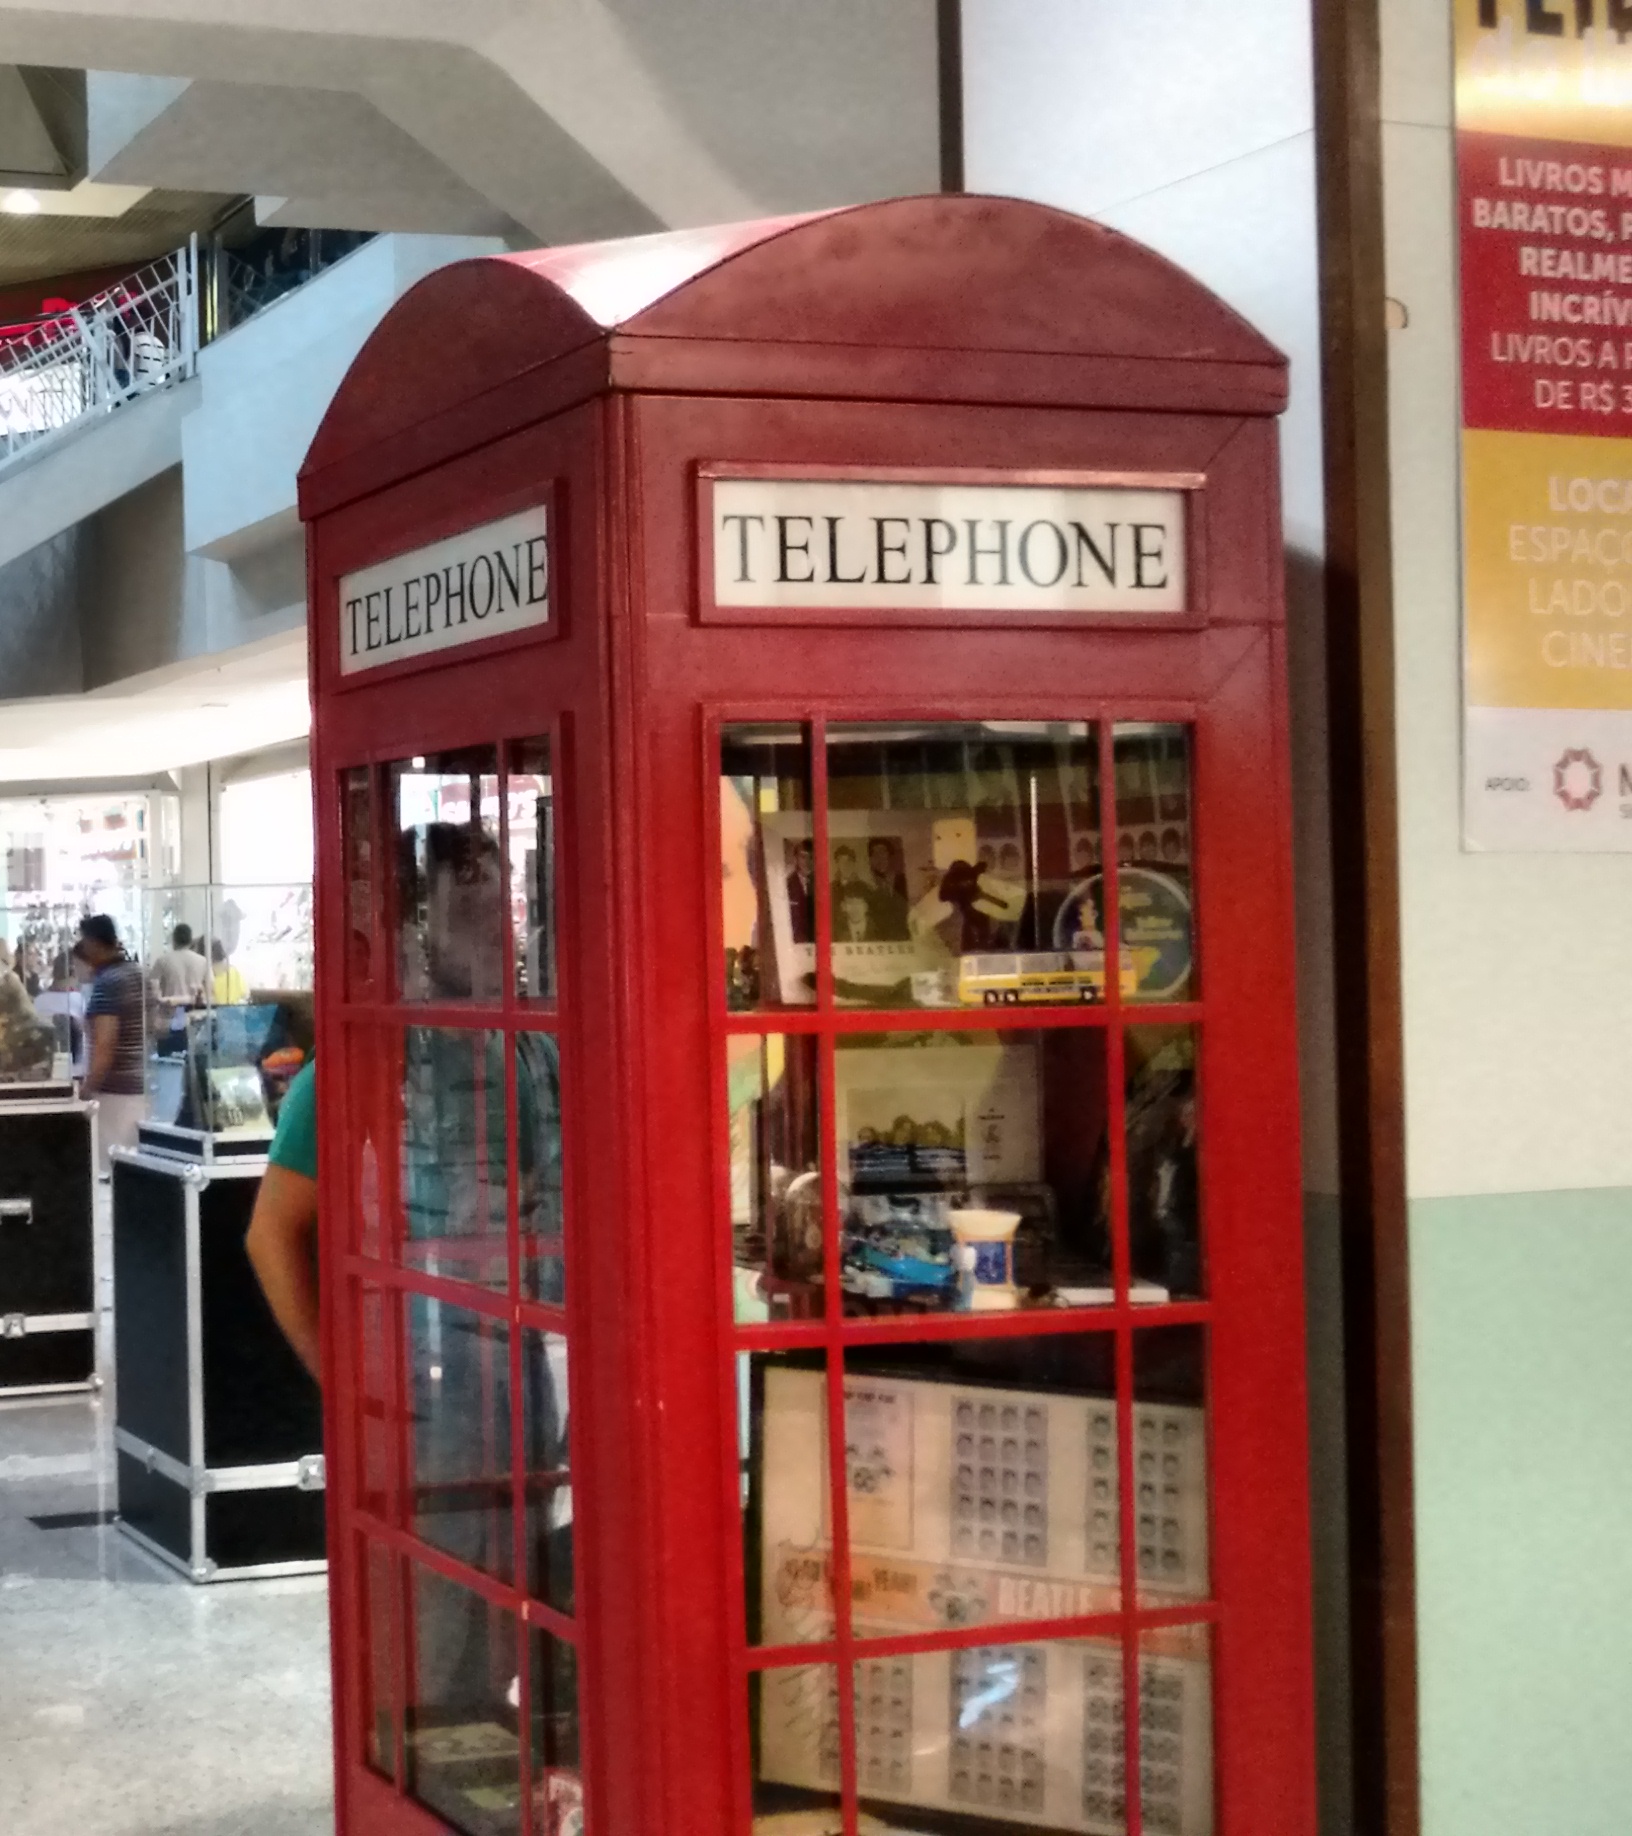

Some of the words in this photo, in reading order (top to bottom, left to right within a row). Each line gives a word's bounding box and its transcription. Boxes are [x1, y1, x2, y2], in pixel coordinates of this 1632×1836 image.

[1499, 157, 1603, 194] LIVROS
[1473, 197, 1614, 243] BARATOS,
[1491, 331, 1593, 368] LIVROS
[1597, 340, 1618, 370] A
[1535, 379, 1574, 410] DE
[1579, 381, 1615, 416] R$
[722, 514, 1168, 589] TELEPHONE
[346, 535, 548, 656] TELEPHONE
[1528, 577, 1627, 617] LADO
[1541, 630, 1632, 670] CINE
